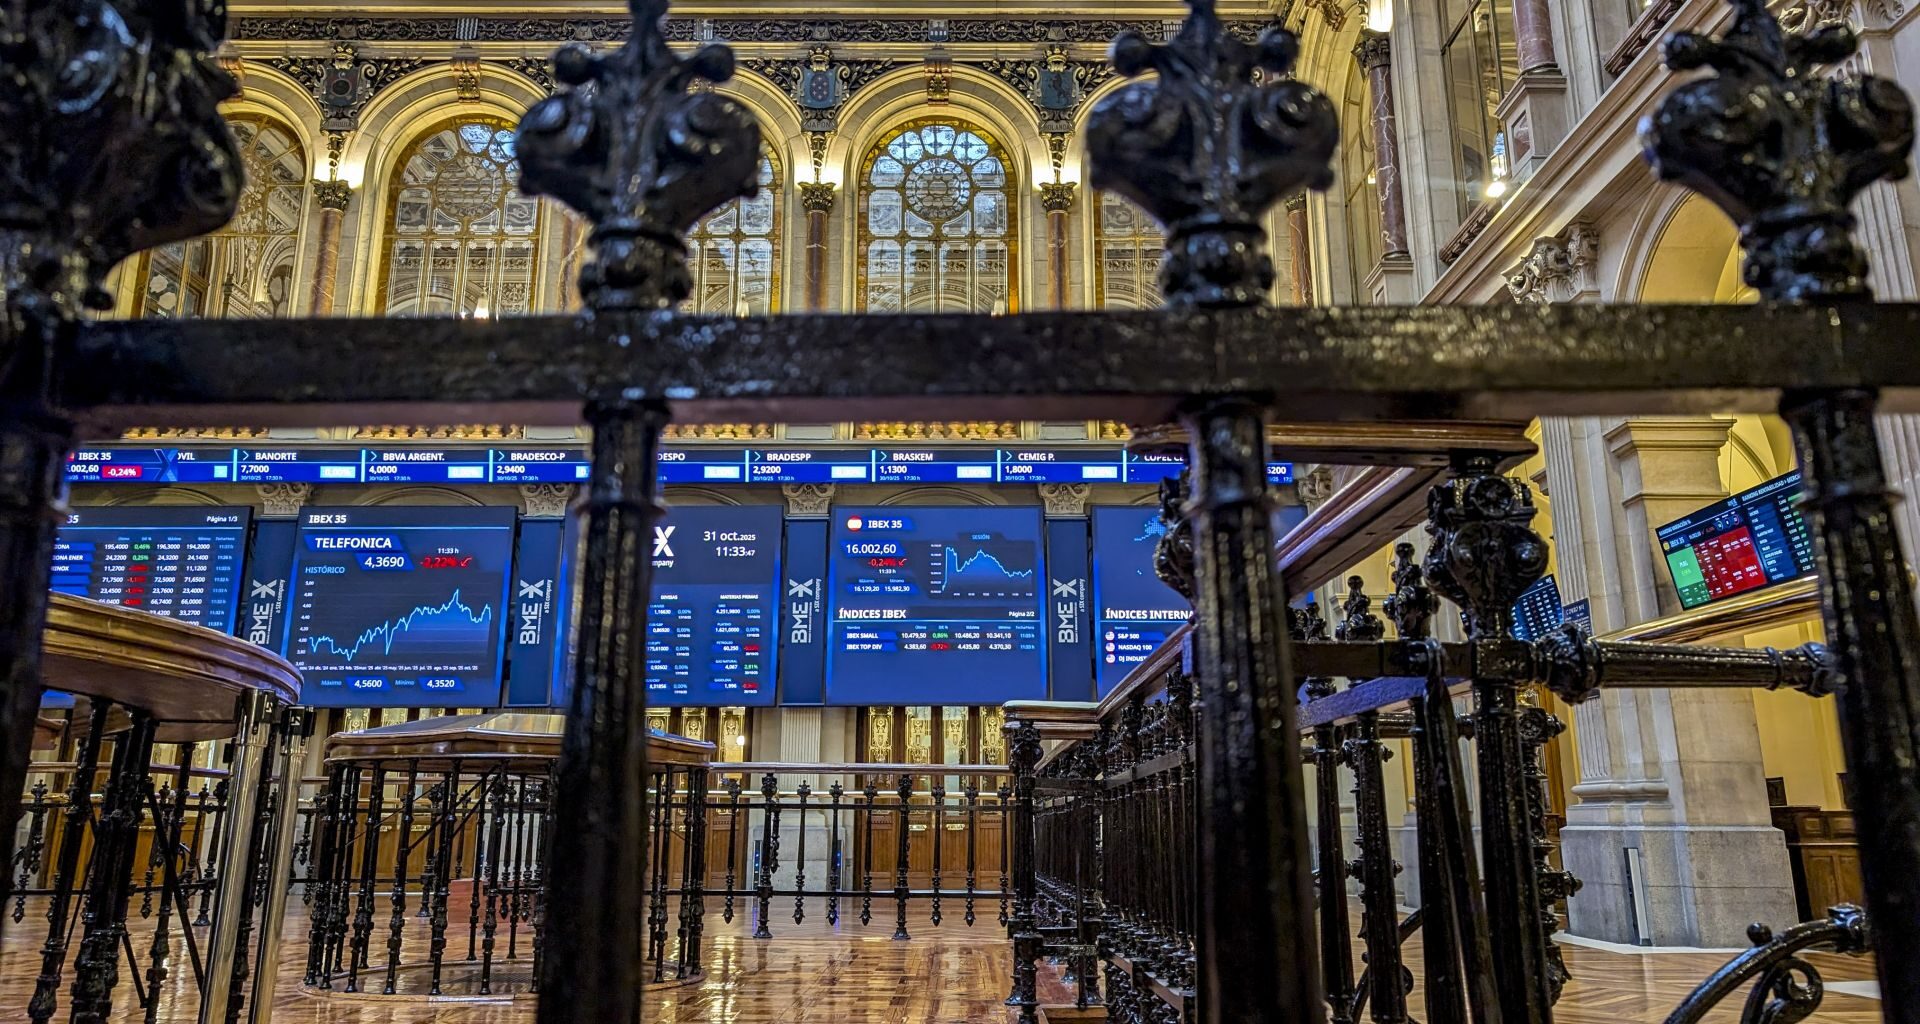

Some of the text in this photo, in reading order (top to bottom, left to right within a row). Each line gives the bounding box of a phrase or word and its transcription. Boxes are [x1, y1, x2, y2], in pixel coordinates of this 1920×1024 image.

[78, 452, 112, 460] IBEX 35
[256, 452, 296, 460] BANORTE
[383, 452, 445, 461] BBVA ARGENT.
[511, 452, 565, 461] BRADESCO-P
[766, 453, 812, 461] BRADESPP
[893, 453, 934, 461] BRASKEM
[1018, 453, 1056, 461] CEMIG P.
[108, 468, 136, 476] -0,24%
[241, 466, 270, 474] 7,7000
[369, 466, 397, 474] 4,0000
[497, 466, 525, 474] 2,9400
[753, 466, 781, 474] 2,9200
[880, 466, 907, 474] 1,1300
[1005, 466, 1032, 474] 1,8000
[309, 515, 347, 523] IBEX 35
[868, 520, 902, 528] IBEX 35
[704, 531, 716, 541] 31
[316, 538, 392, 548] TELEFONICA
[846, 544, 897, 554] 16.002,60
[364, 556, 404, 568] 4,3690
[305, 564, 345, 574] HISTÓRICO
[839, 608, 880, 618] ÍNDICES
[882, 610, 906, 618] IBEX
[1106, 608, 1147, 619] ÍNDICES
[250, 603, 270, 645] BME
[520, 603, 538, 644] BME
[792, 602, 808, 643] BME
[1058, 602, 1074, 643] BME
[354, 680, 382, 688] 4,5600
[427, 680, 455, 688] 4,3520
